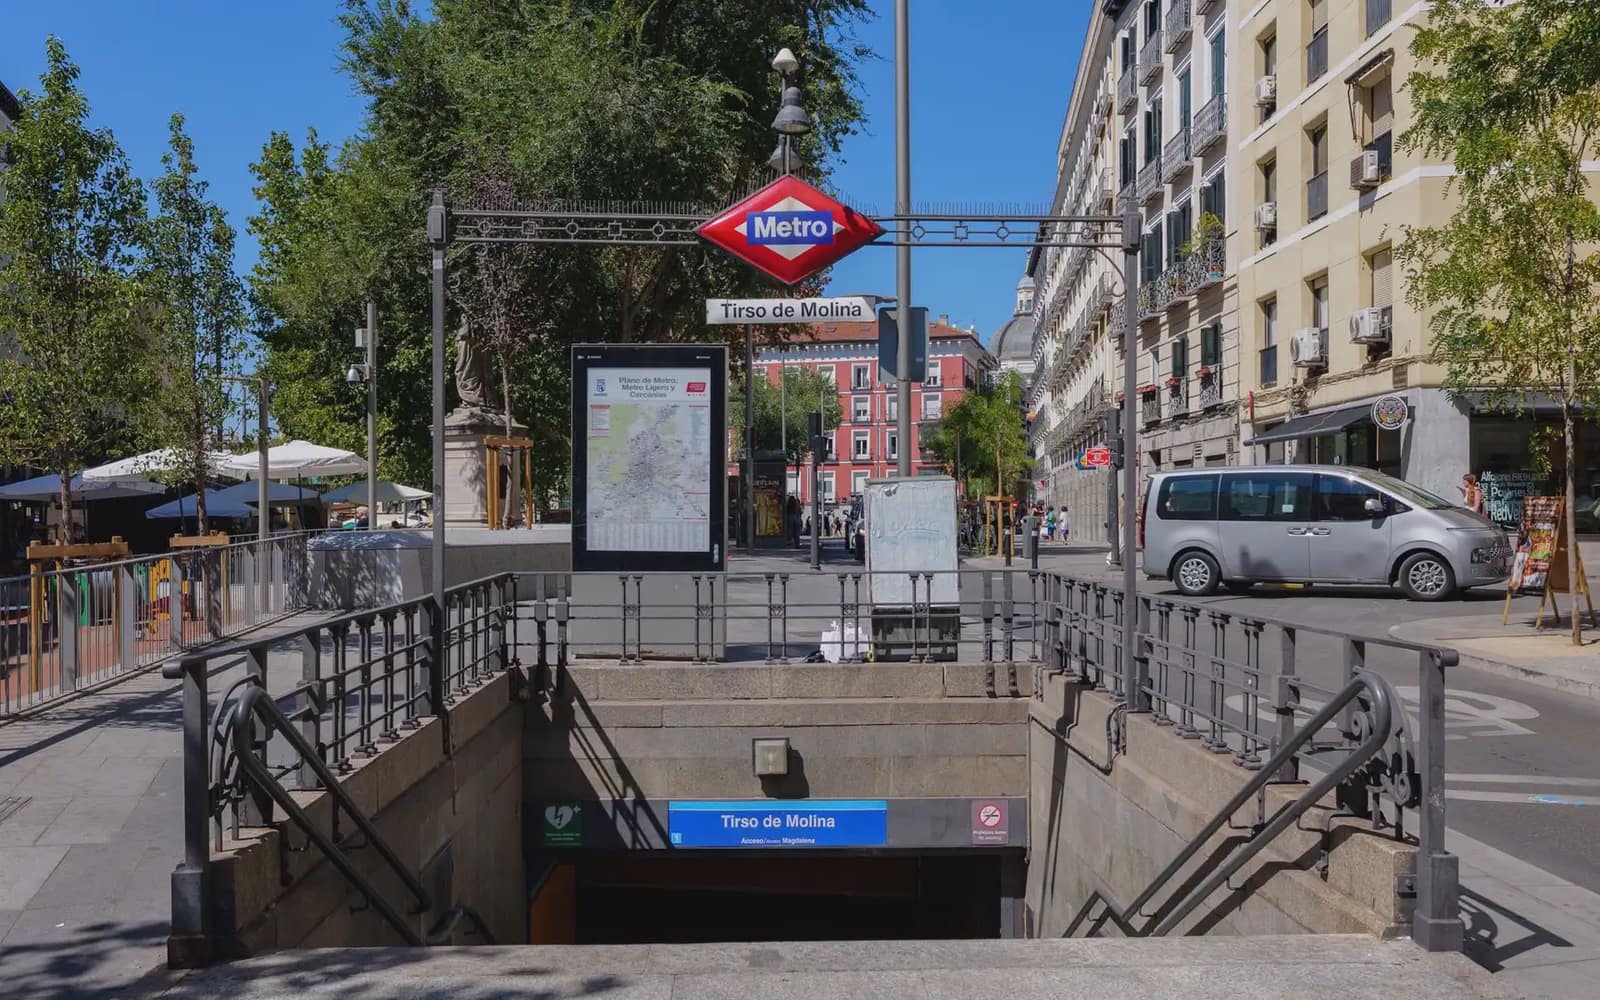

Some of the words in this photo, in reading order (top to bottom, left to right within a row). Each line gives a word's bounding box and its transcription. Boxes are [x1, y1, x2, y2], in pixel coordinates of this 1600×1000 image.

[755, 217, 828, 238] Metro
[721, 302, 767, 318] Tirso
[772, 302, 795, 318] de
[801, 302, 862, 317] Molina
[645, 384, 670, 392] Ligero
[721, 814, 759, 828] Tirso
[763, 814, 781, 828] de
[786, 814, 836, 828] Molina
